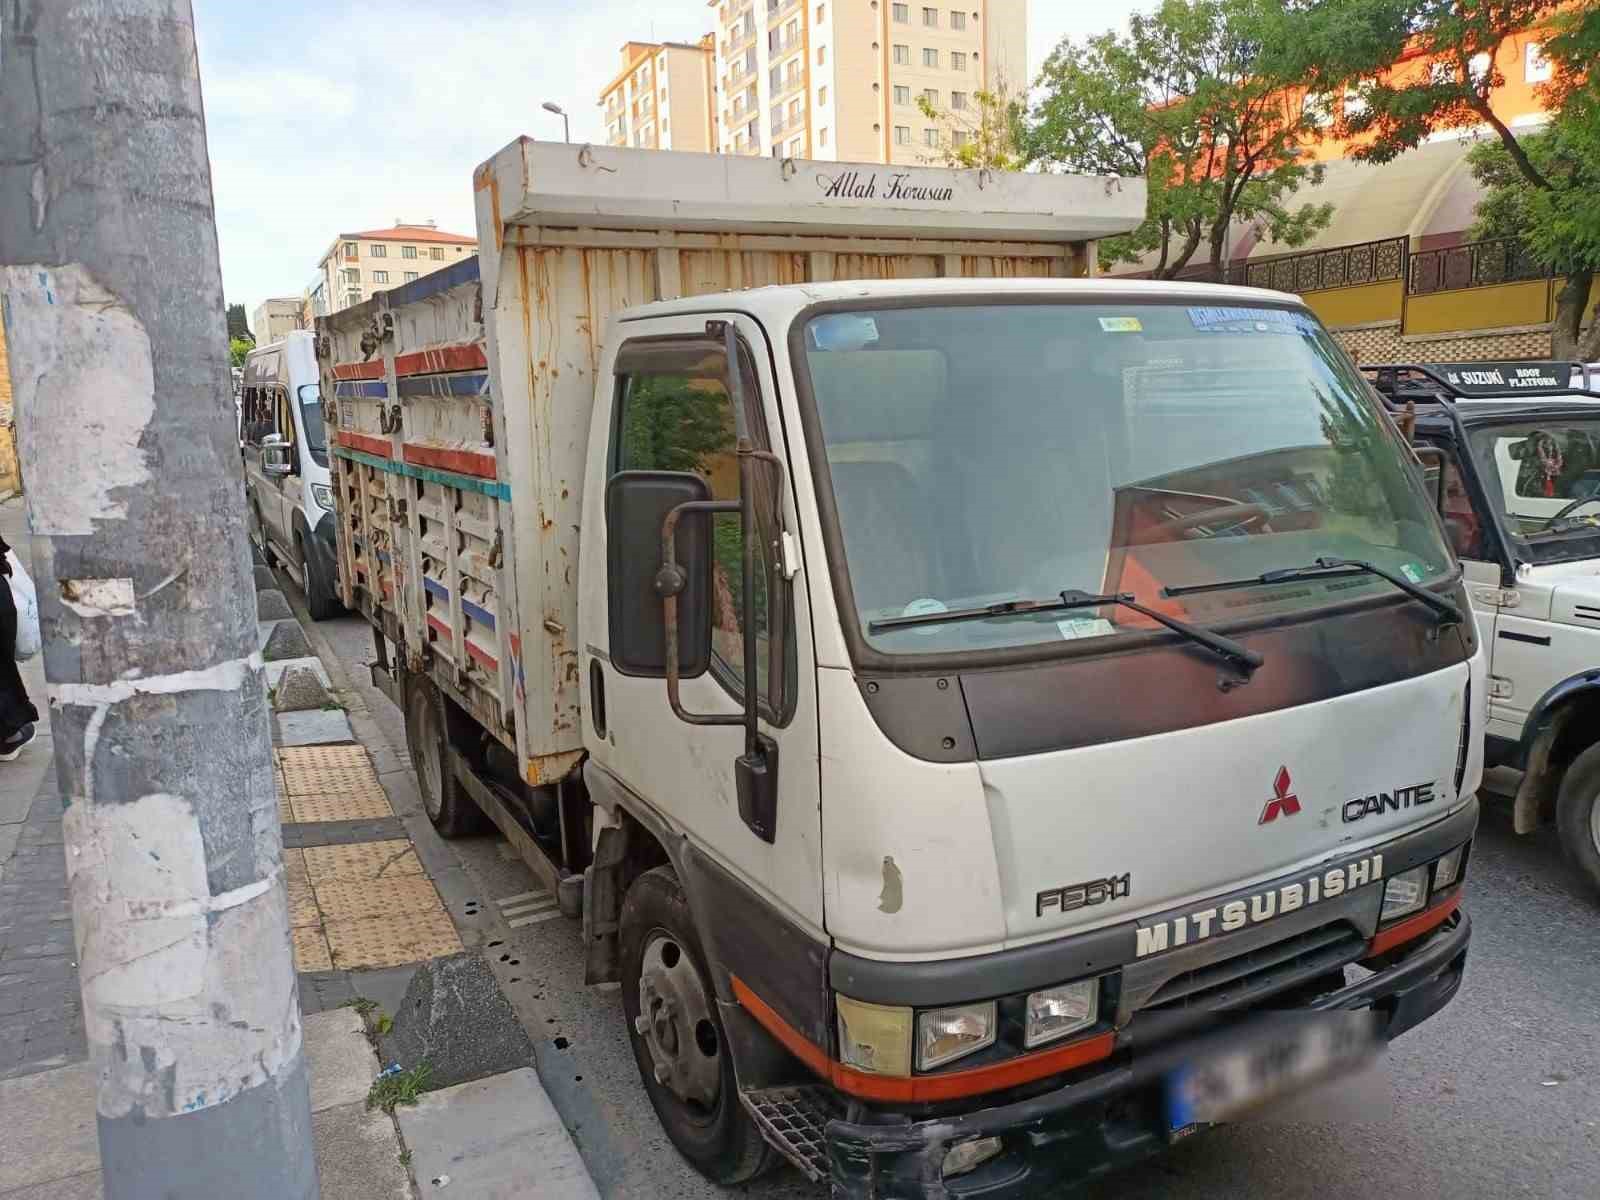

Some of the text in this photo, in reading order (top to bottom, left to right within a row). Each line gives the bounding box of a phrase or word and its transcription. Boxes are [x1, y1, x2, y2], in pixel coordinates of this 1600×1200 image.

[816, 171, 876, 199] Allah
[1508, 377, 1558, 387] PLATFORM
[1342, 781, 1434, 823] CANTE
[1136, 855, 1383, 957] MITSUBISHI
